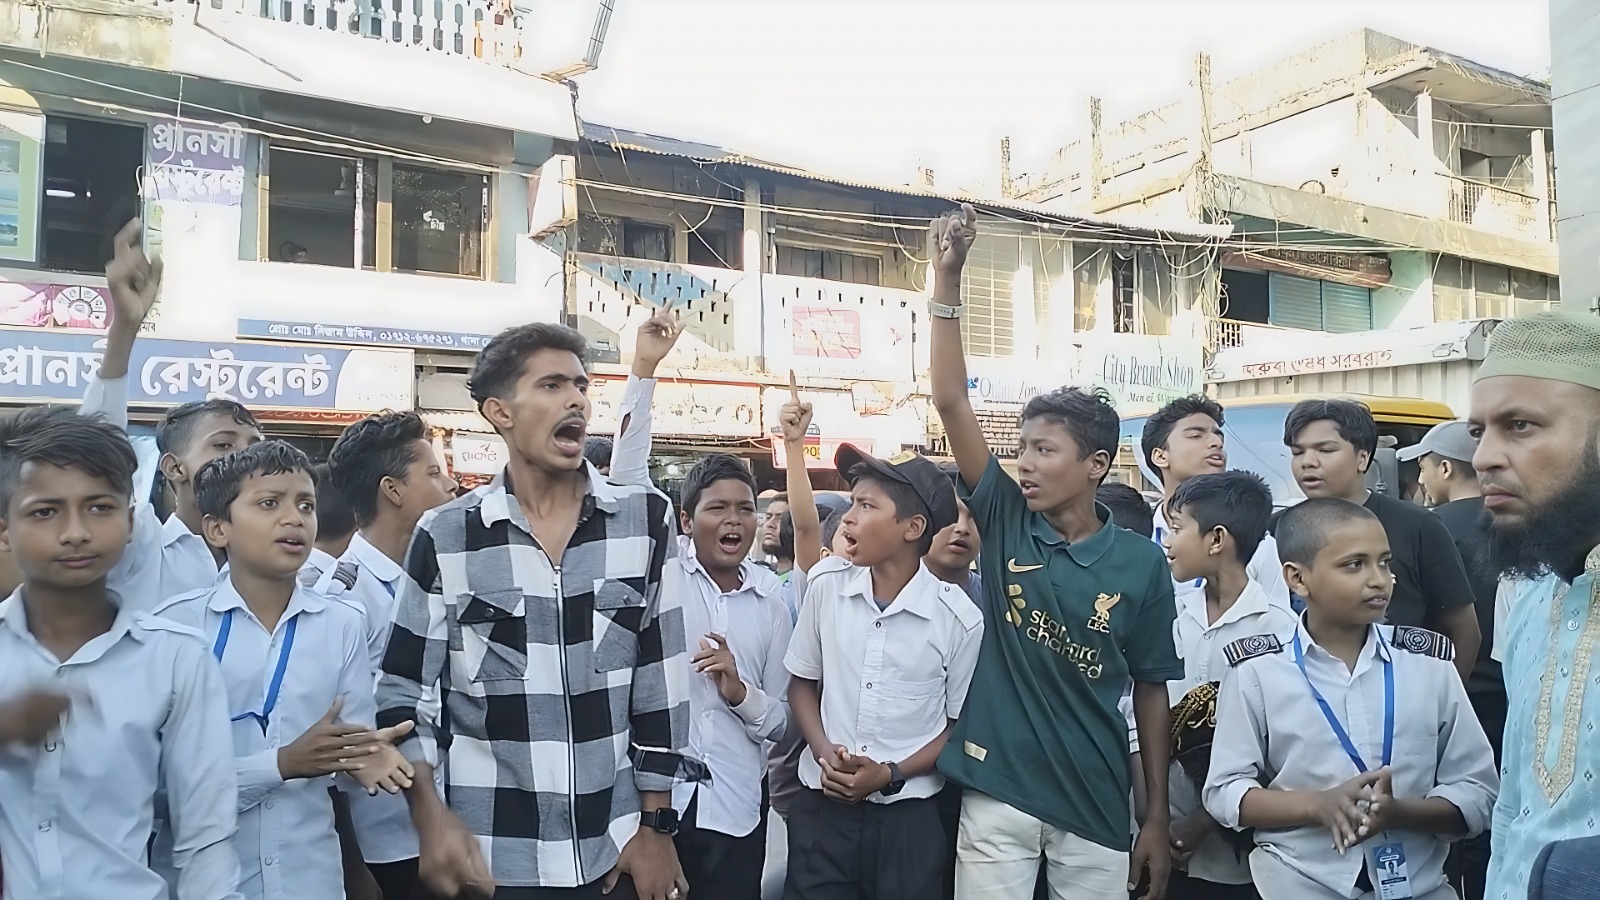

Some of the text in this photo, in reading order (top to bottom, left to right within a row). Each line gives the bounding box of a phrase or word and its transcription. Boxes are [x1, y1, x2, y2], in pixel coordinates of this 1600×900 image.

[141, 348, 331, 400] রেস্টুরেন্ট
[1129, 355, 1163, 387] Brand
[1167, 355, 1194, 394] Shop
